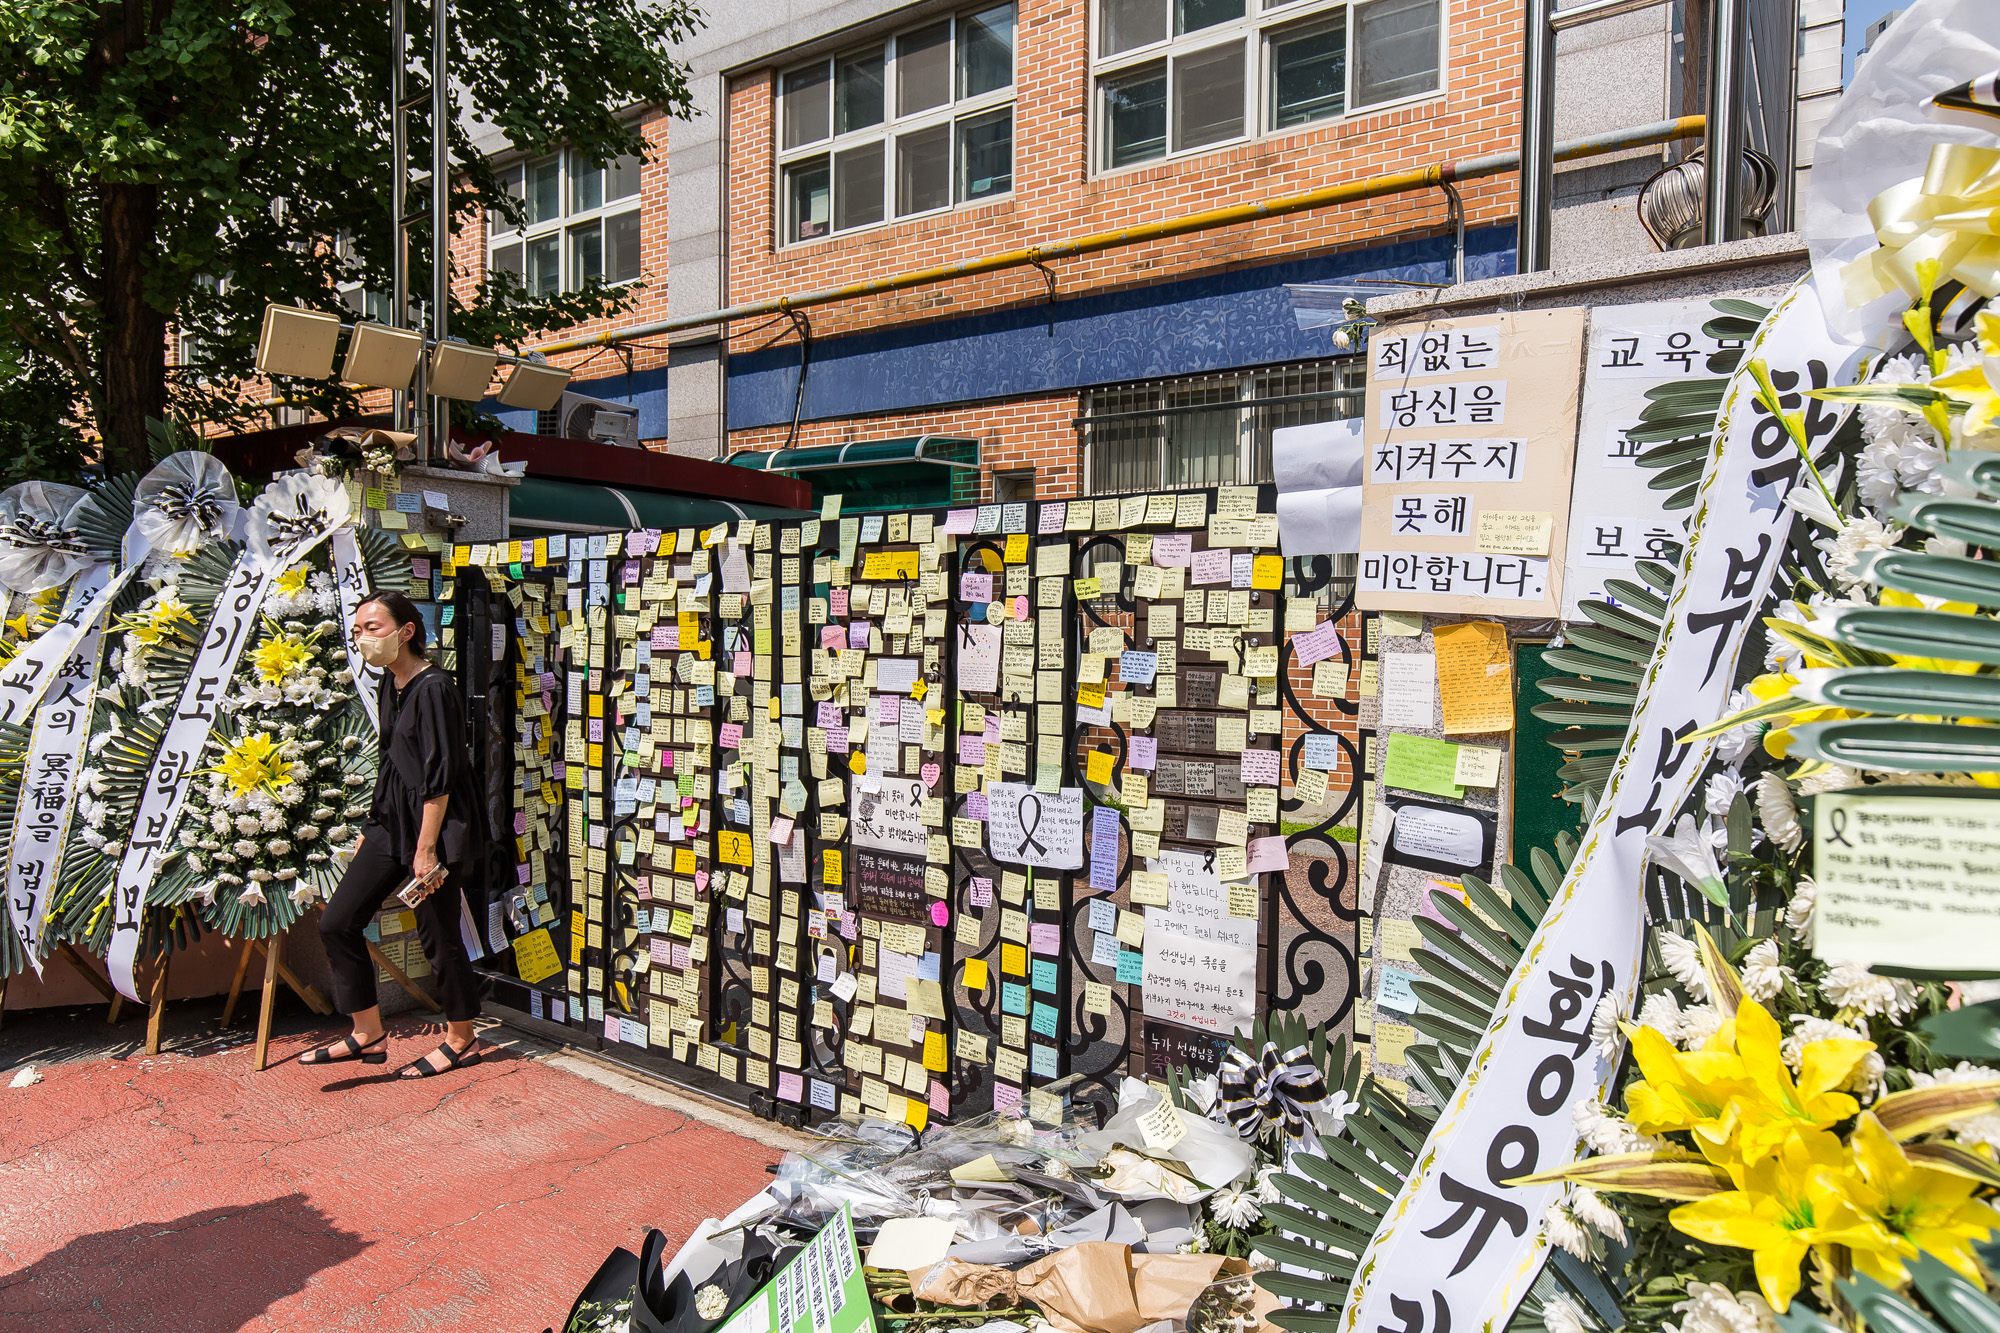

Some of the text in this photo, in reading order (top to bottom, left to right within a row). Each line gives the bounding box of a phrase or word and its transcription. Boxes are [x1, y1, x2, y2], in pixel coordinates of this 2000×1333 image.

[1378, 333, 1494, 373] 죄 없는
[1390, 385, 1502, 428] 당신을
[1374, 441, 1519, 481] 지켜주지
[1394, 496, 1467, 534] 못해
[1364, 554, 1543, 598] 미안합니다.
[1616, 359, 1838, 838] 학부모
[176, 569, 263, 724] 경기도
[26, 751, 73, 843] 冥福을
[116, 751, 191, 931] 학부모
[1159, 948, 1228, 973] 선생님의 죽음을
[1166, 1009, 1186, 1020] 그것이
[1177, 1041, 1215, 1064] 선생님을
